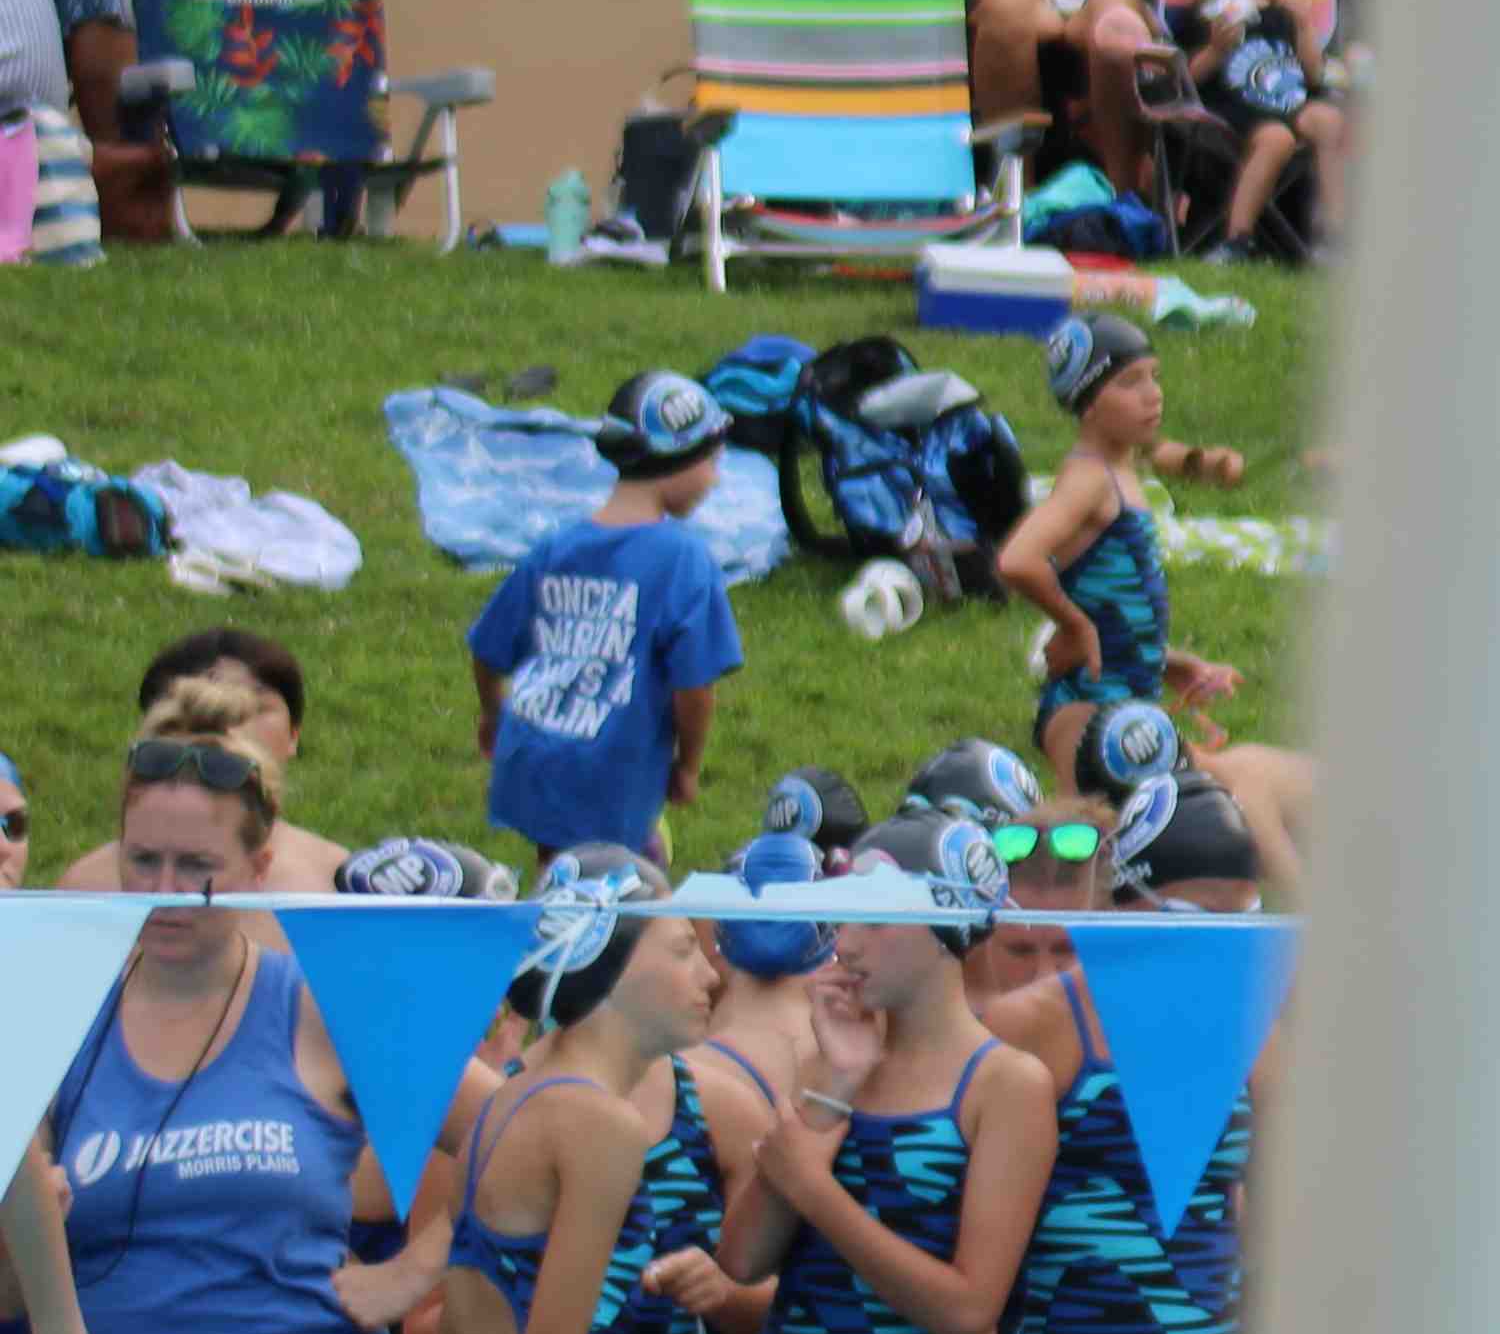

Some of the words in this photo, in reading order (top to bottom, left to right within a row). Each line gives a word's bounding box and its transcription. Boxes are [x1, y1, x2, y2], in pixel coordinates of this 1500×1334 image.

[612, 581, 638, 622] A
[369, 853, 426, 894] MP
[125, 1120, 294, 1172] JAZZERCISE
[178, 1154, 242, 1179] MORRIS
[246, 1153, 300, 1175] PLAINS
